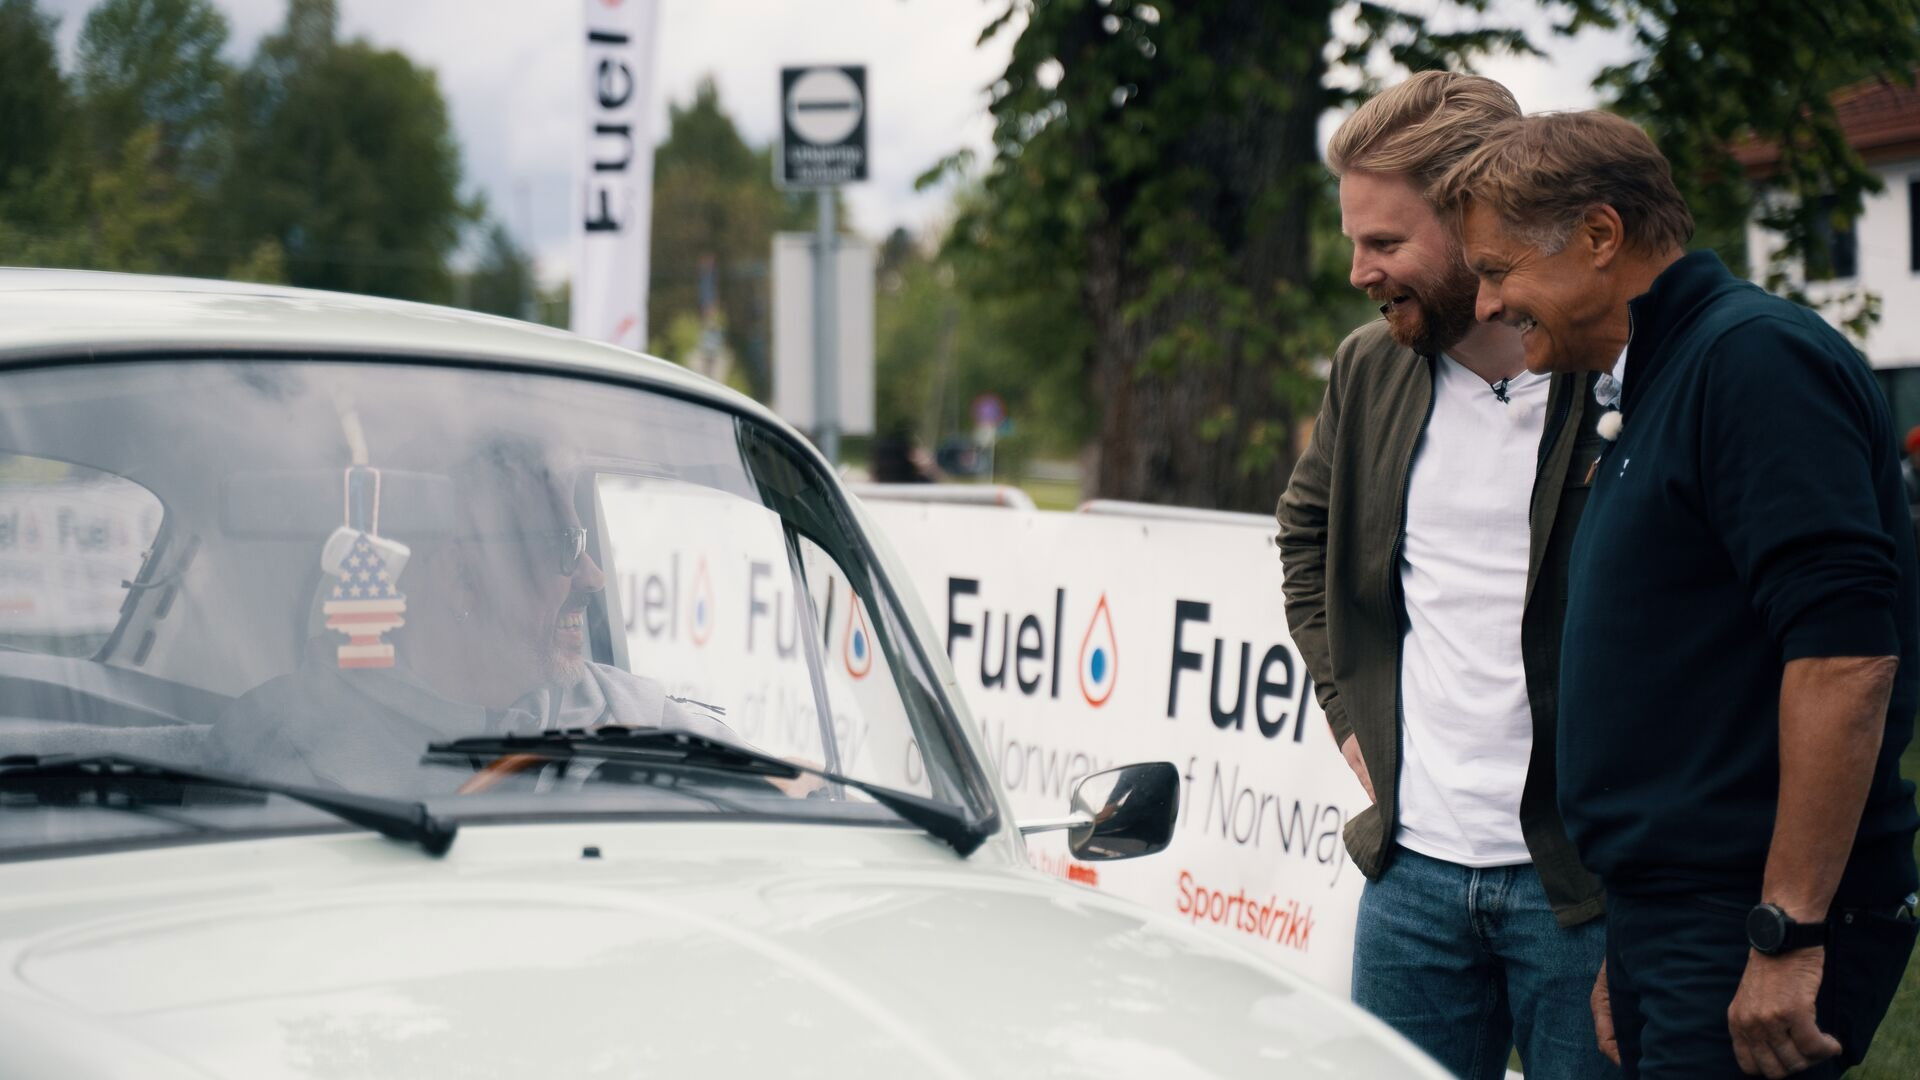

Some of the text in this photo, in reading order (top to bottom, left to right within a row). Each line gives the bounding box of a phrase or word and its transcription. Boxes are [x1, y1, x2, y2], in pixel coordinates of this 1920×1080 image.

[584, 30, 634, 233] Fuel
[617, 552, 681, 642] uel
[947, 576, 1065, 699] Fuel
[1167, 599, 1314, 744] Fuel
[980, 718, 1114, 800] Norwa
[1181, 755, 1198, 829] f
[1176, 869, 1315, 952] Sportsdrikk
